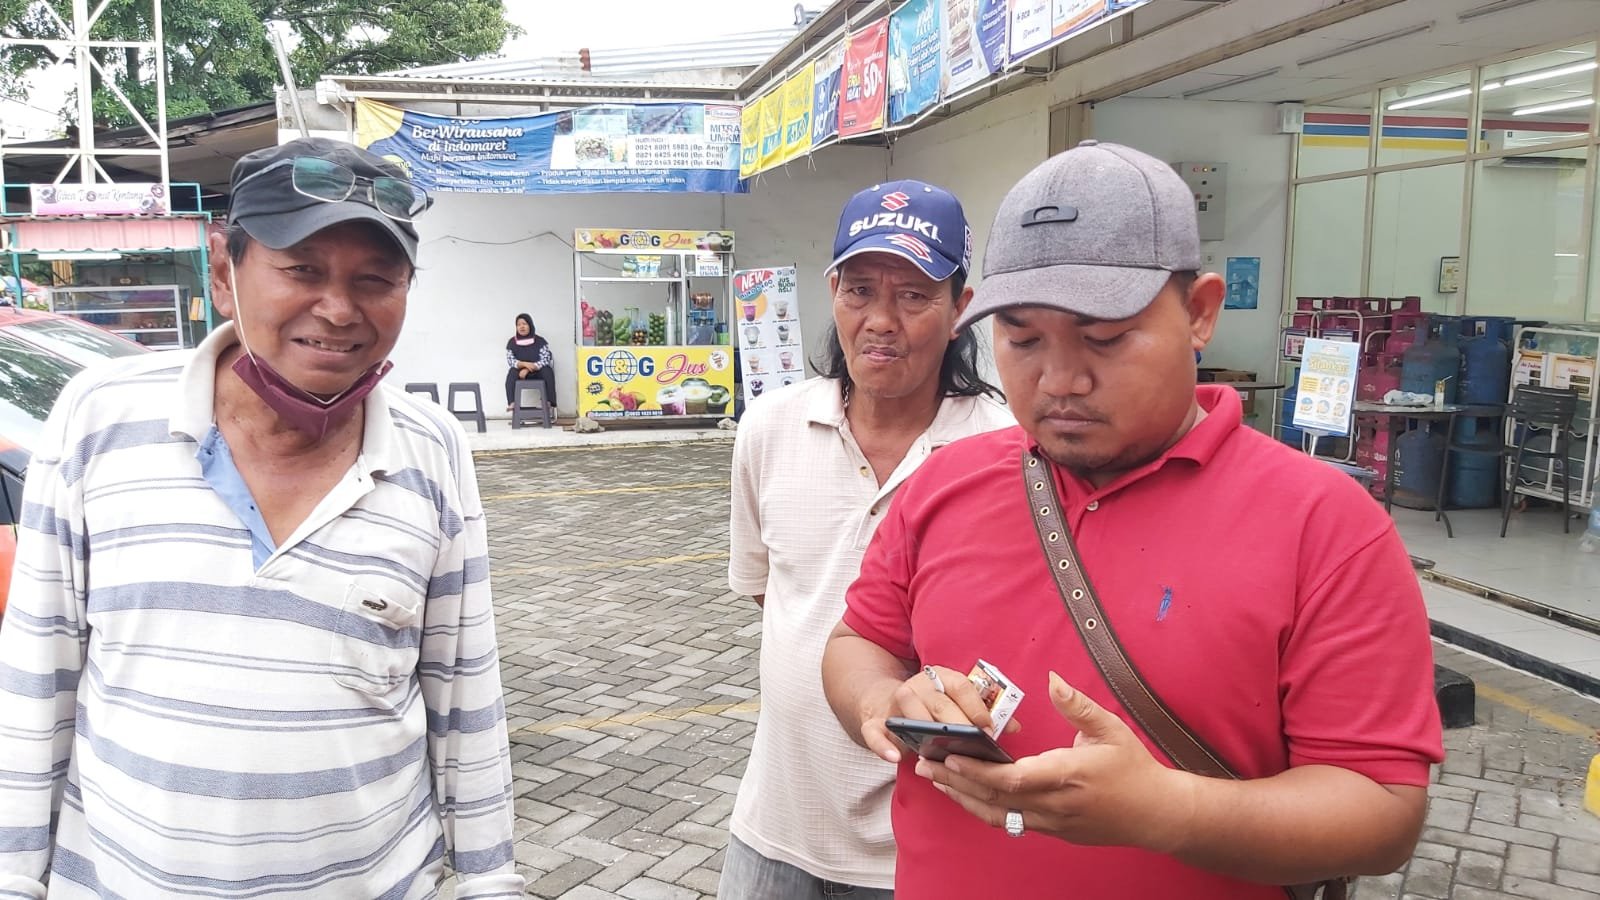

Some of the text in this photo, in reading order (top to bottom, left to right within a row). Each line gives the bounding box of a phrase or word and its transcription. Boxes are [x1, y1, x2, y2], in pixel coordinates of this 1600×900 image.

[710, 124, 740, 133] MITRA
[428, 140, 440, 152] di
[849, 213, 942, 244] SUZUKI
[741, 270, 765, 292] NEW
[656, 353, 708, 384] Jus
